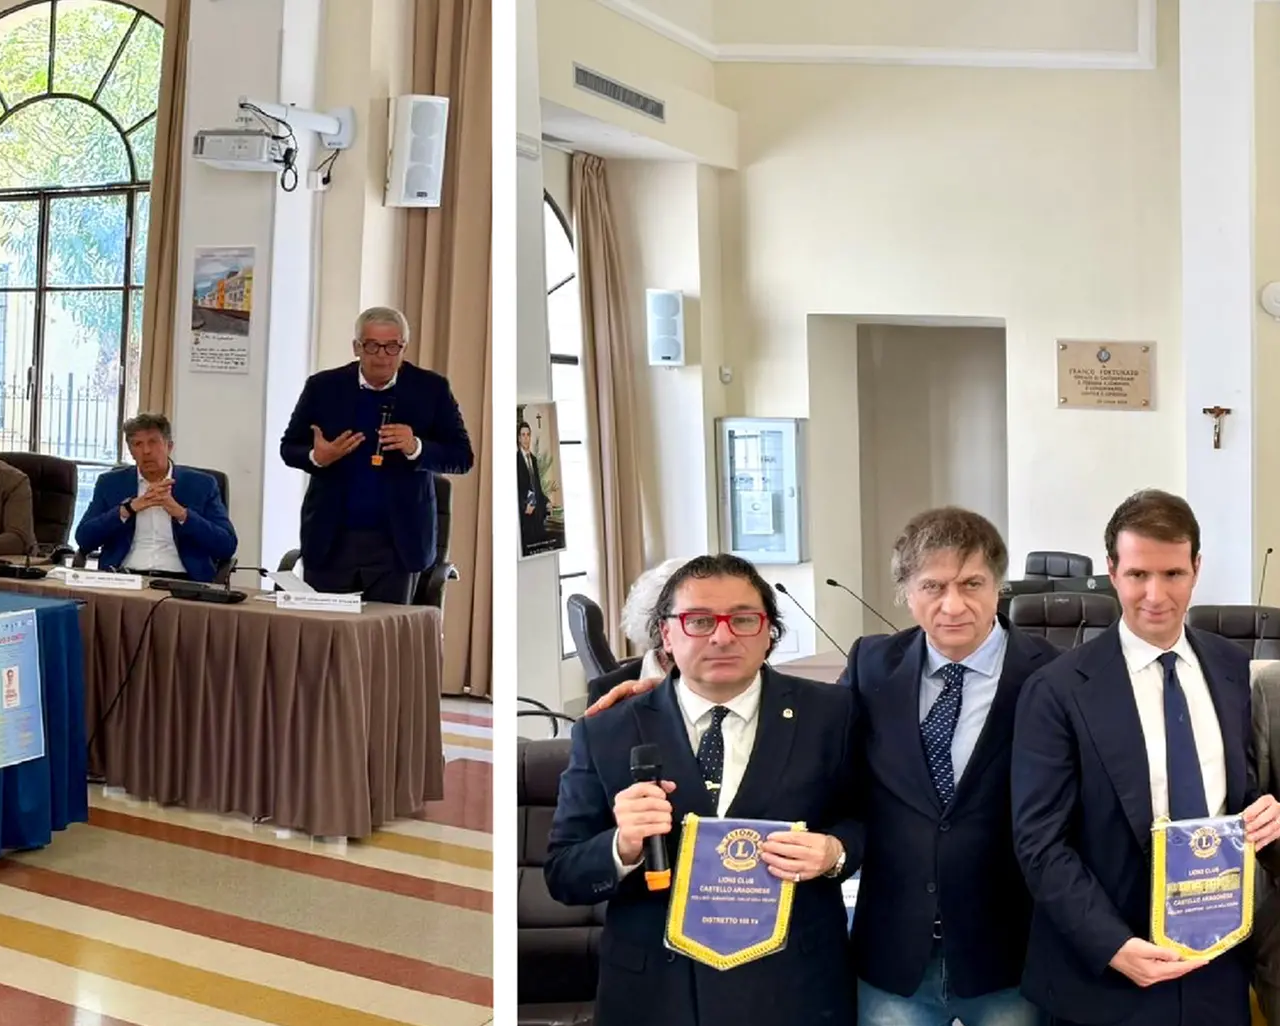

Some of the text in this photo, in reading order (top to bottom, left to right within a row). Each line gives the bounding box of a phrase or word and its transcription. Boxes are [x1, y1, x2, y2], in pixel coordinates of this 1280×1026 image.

[734, 841, 749, 858] L
[699, 885, 733, 893] CASTELLO
[702, 916, 738, 924] DISTRETTO
